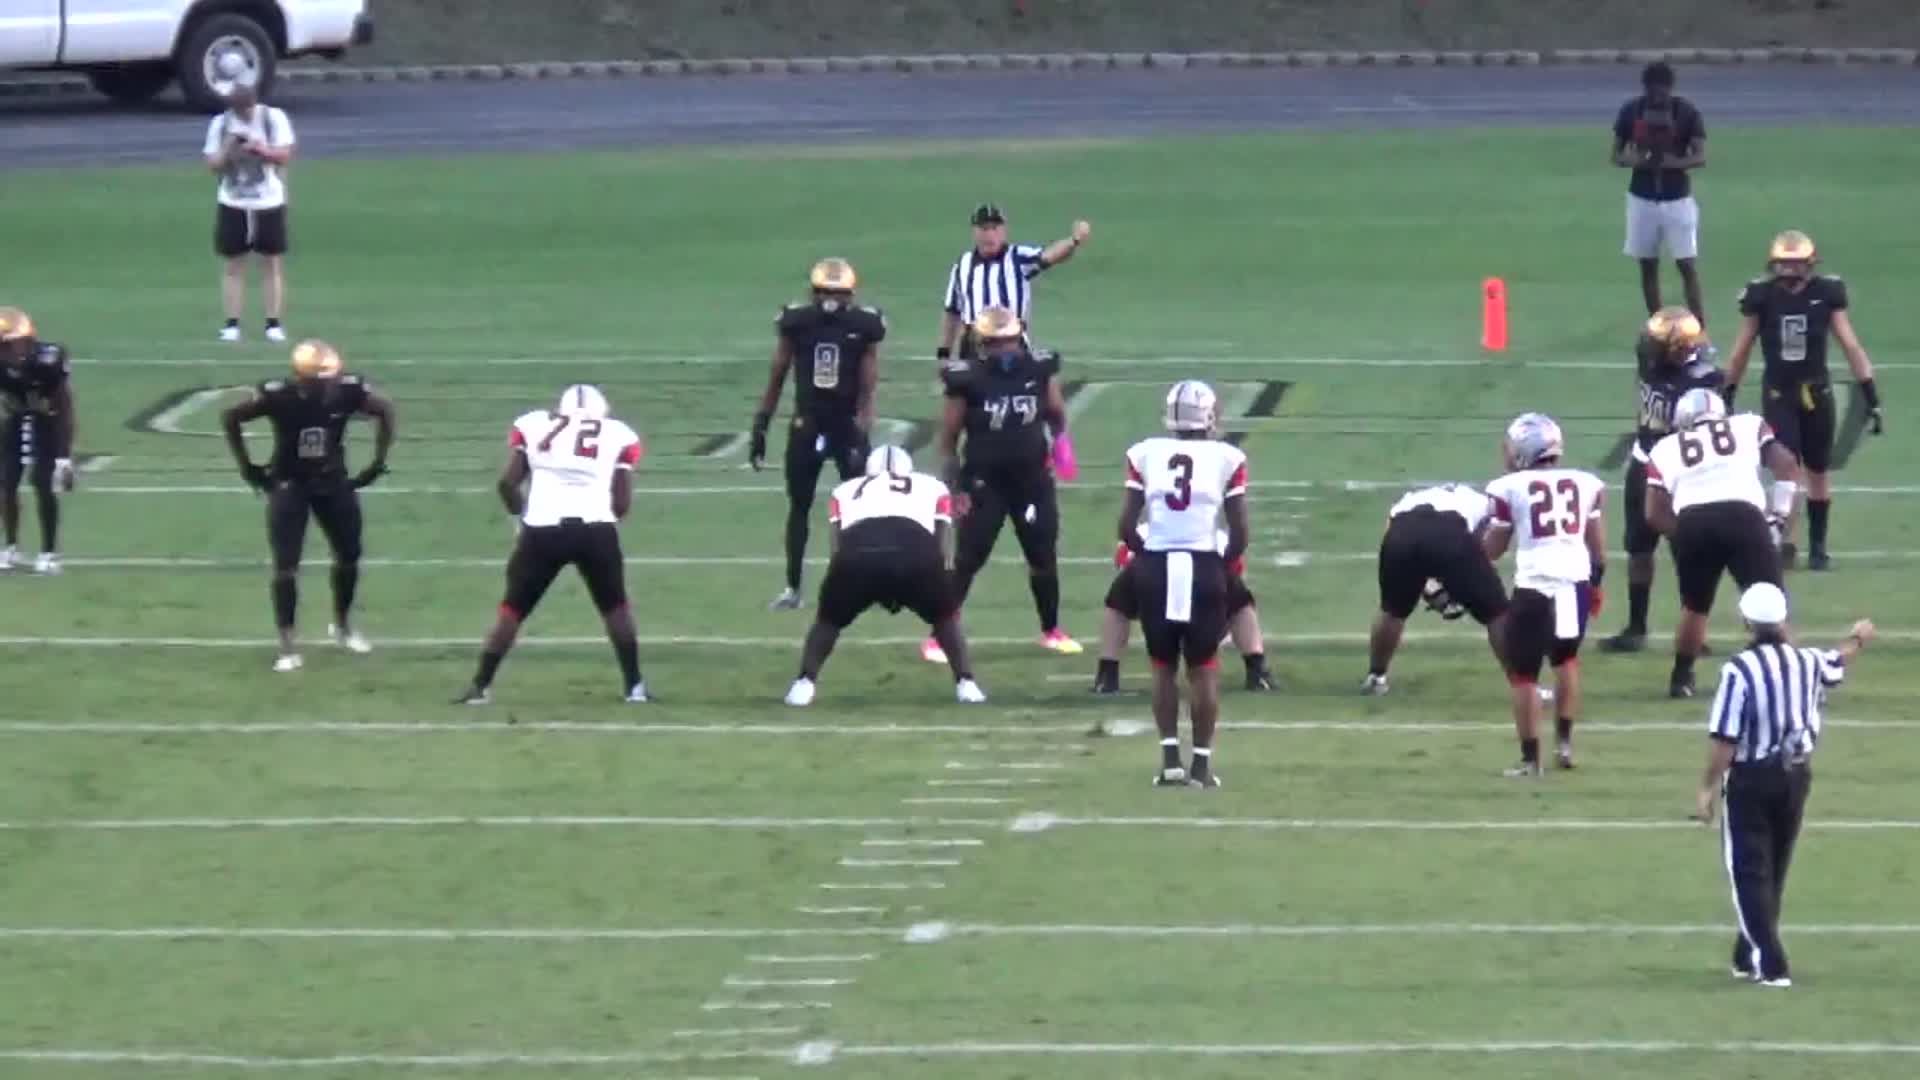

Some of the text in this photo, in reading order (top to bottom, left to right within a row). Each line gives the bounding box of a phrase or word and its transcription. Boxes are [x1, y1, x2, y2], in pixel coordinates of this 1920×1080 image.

[1781, 313, 1807, 361] 6
[537, 411, 602, 459] 72
[1678, 417, 1737, 468] 68
[1164, 452, 1193, 511] 3
[1528, 478, 1580, 539] 23
